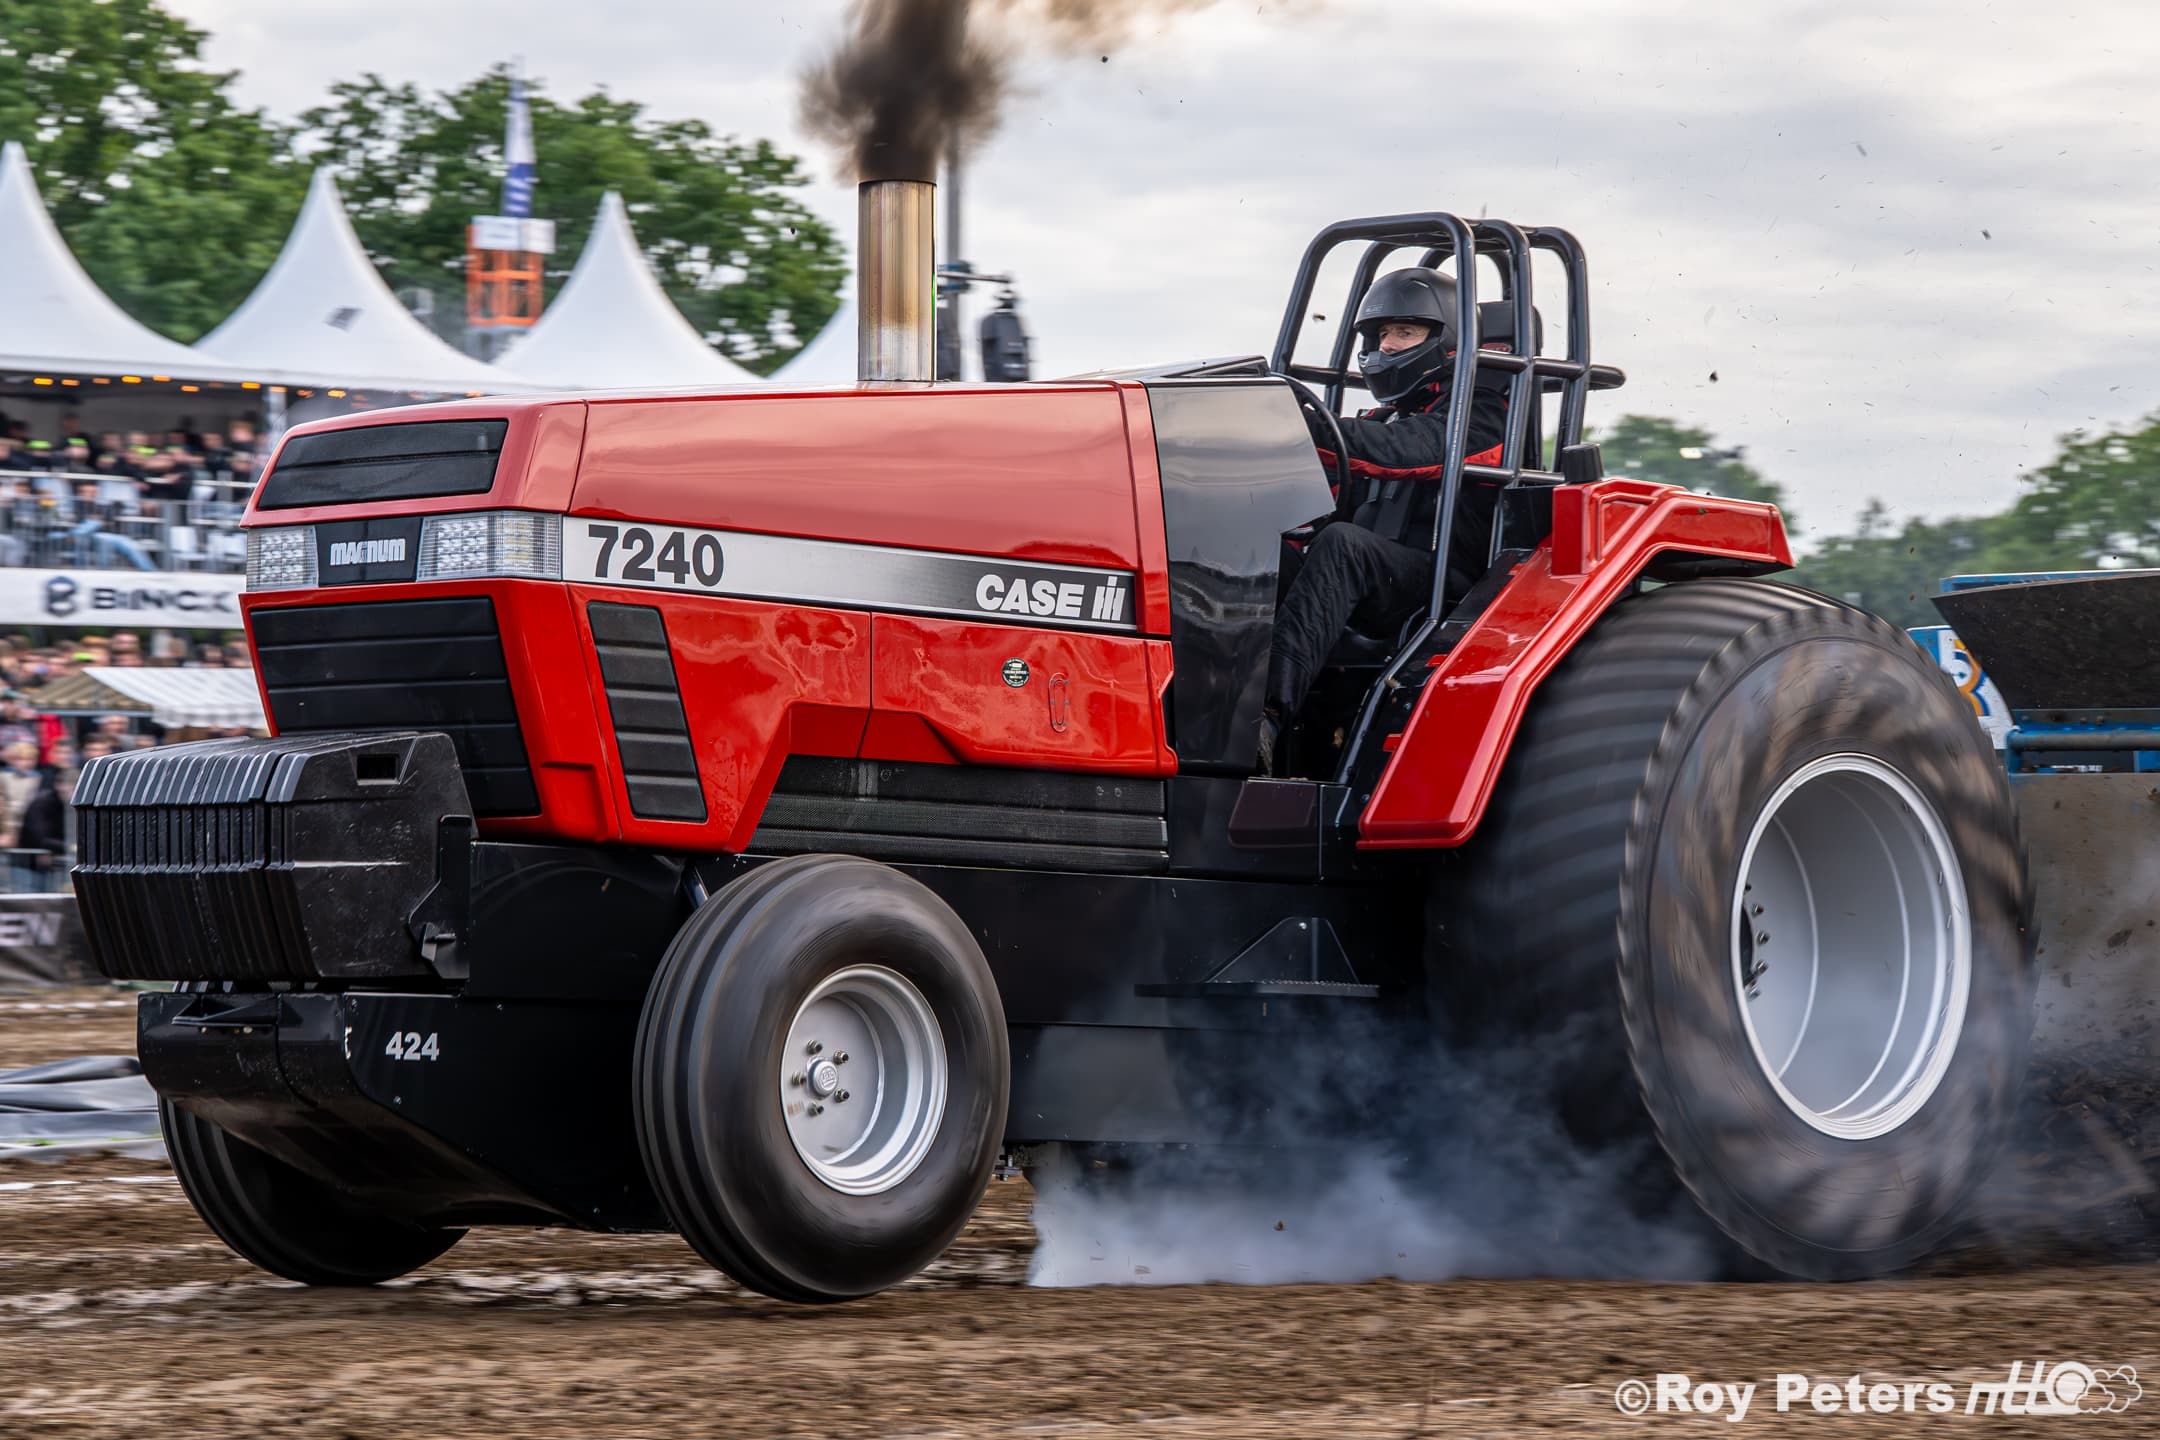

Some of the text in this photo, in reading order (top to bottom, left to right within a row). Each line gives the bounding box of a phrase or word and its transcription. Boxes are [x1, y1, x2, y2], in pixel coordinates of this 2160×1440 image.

[588, 524, 724, 587] 7240
[976, 574, 1085, 617] CASE
[385, 1031, 440, 1061] 424
